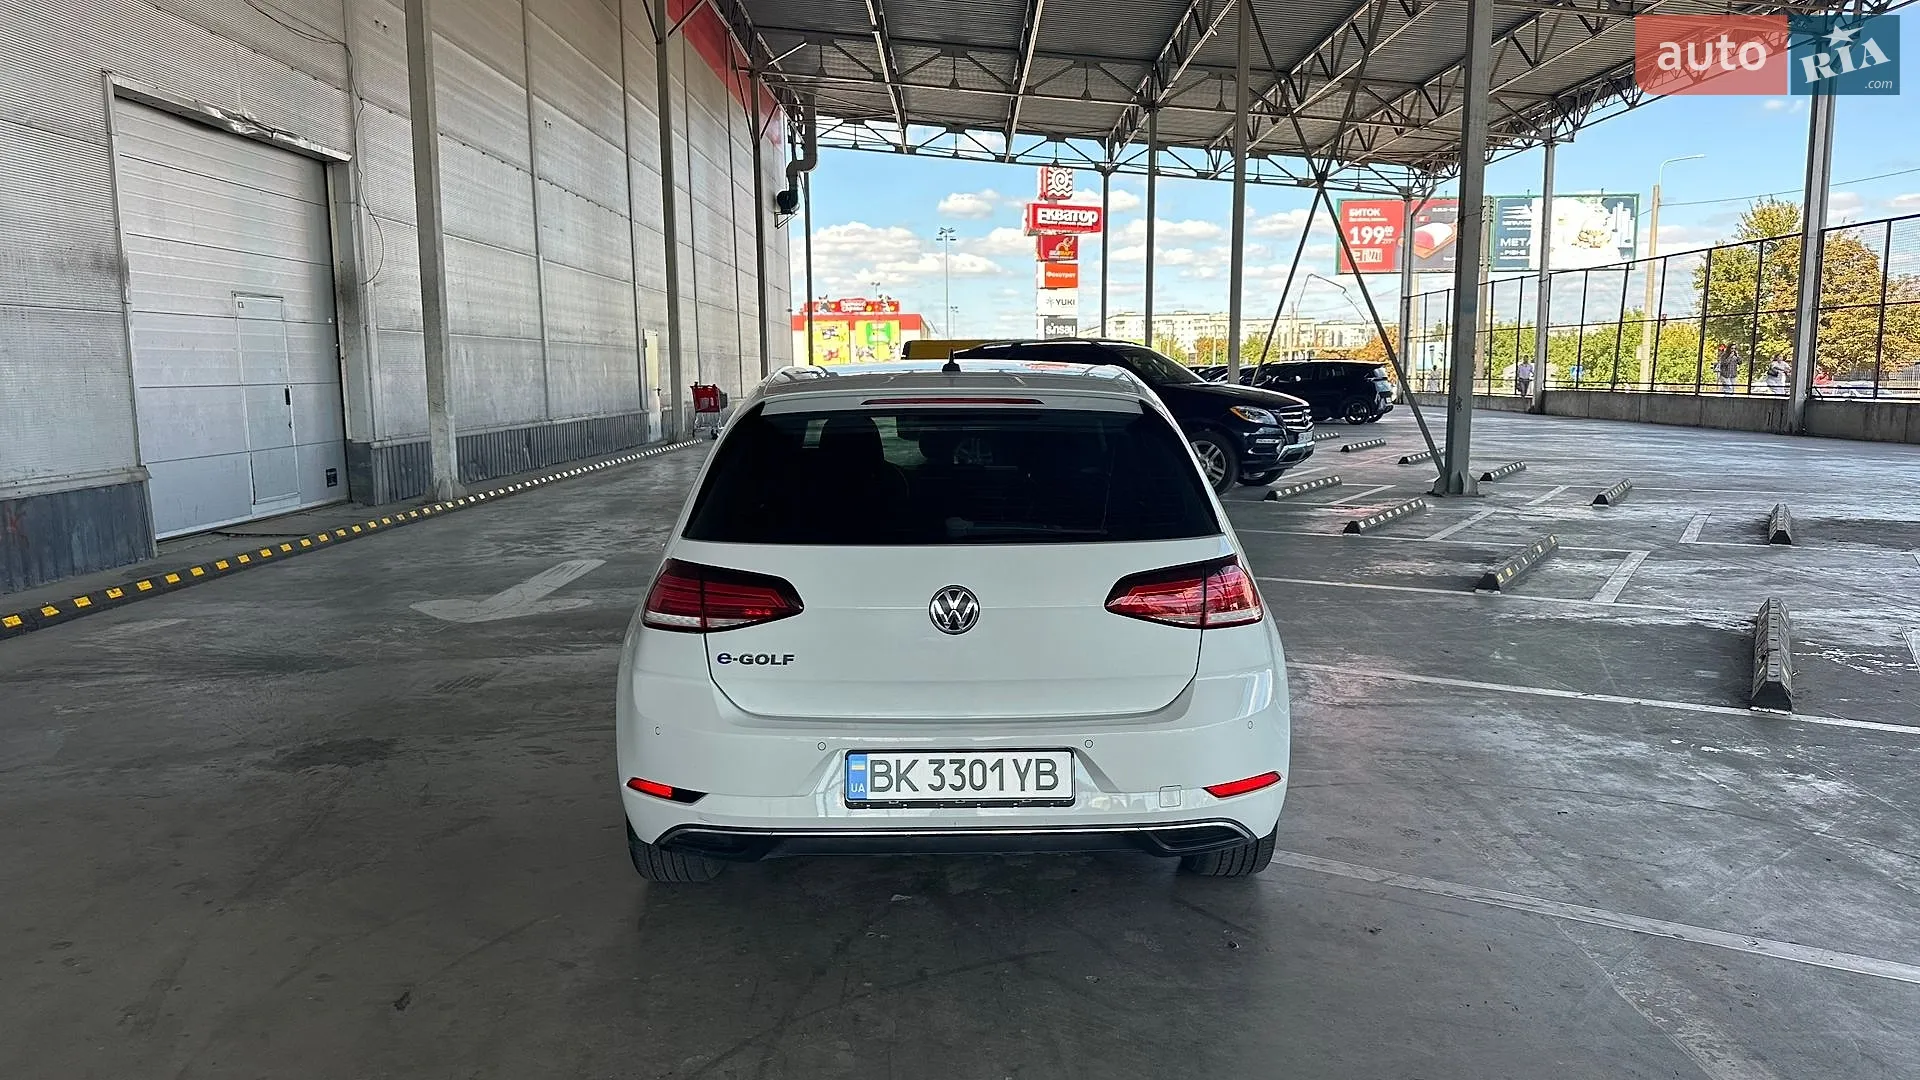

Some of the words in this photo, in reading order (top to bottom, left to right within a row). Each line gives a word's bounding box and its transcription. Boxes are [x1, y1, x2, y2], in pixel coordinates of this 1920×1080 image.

[1348, 207, 1381, 217] БИТОК
[1350, 225, 1384, 245] 199
[1045, 322, 1076, 338] sinsay
[716, 652, 795, 666] e-GOLF
[870, 759, 920, 793] BK
[928, 758, 1004, 792] 3301
[1012, 758, 1059, 792] YB
[851, 783, 866, 793] UA
